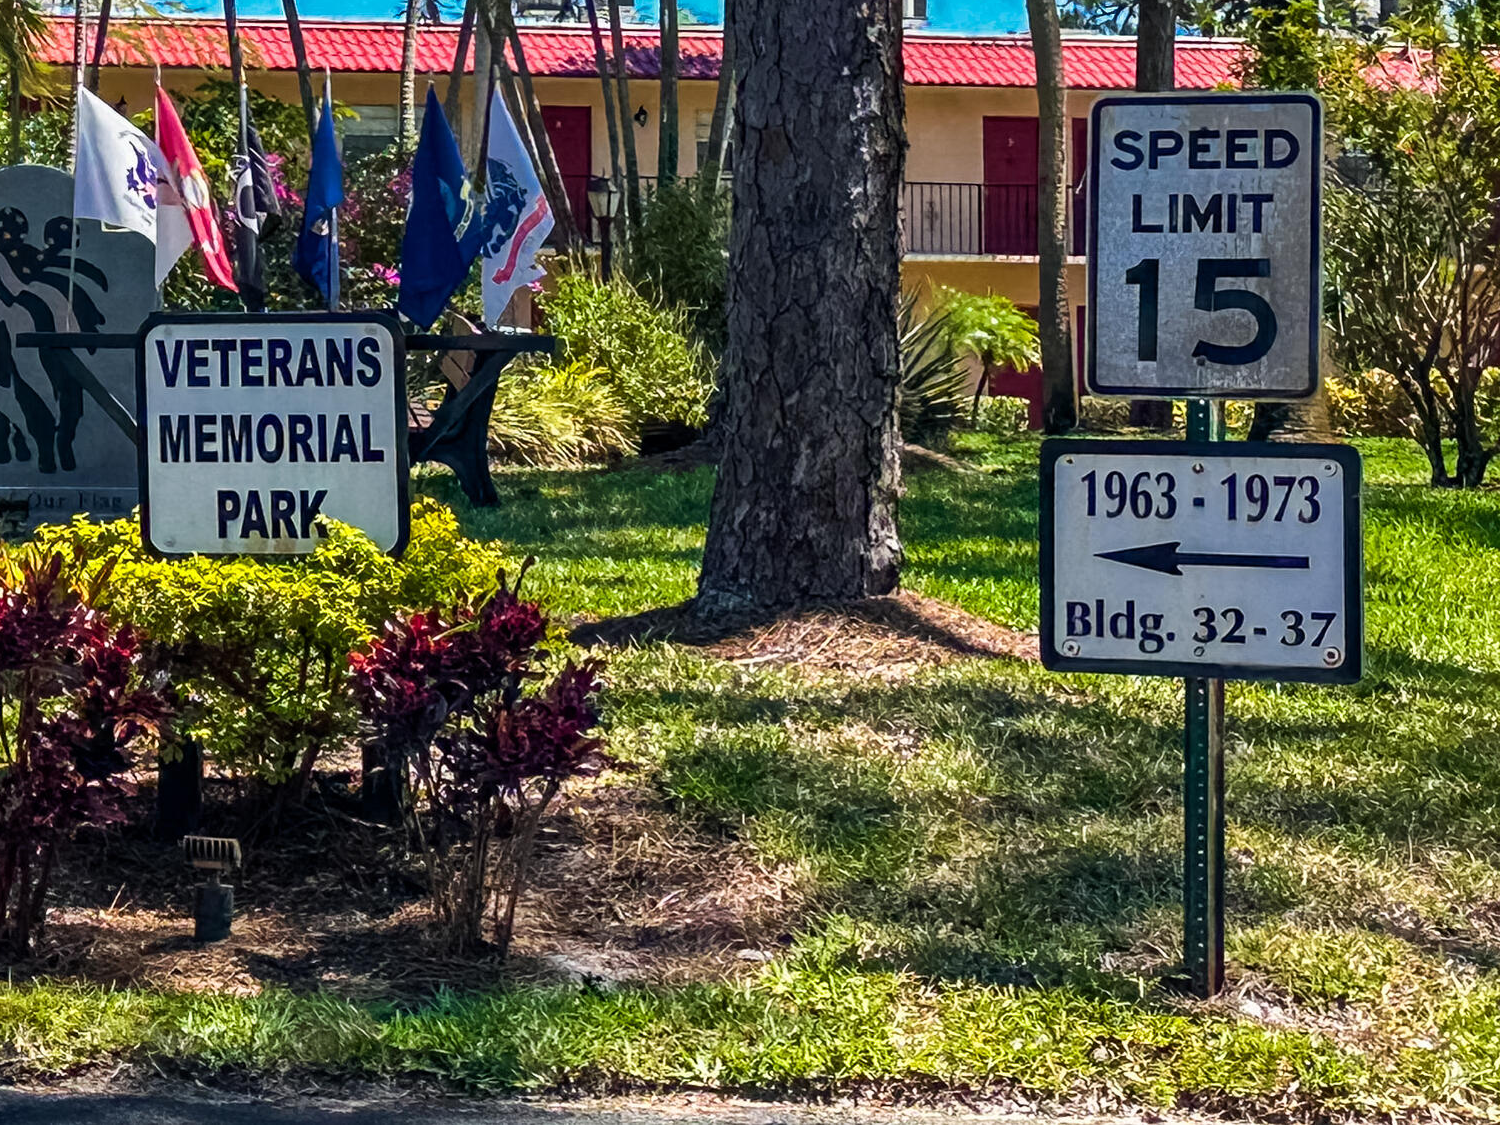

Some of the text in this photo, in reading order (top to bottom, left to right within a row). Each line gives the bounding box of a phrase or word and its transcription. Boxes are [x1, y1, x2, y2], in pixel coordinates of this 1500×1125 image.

[1111, 129, 1300, 169] SPEED
[1132, 194, 1273, 233] LIMIT
[1125, 258, 1278, 365] 15
[155, 337, 382, 387] VETERANS
[159, 414, 384, 463] MEMORIAL
[27, 491, 68, 508] Our
[217, 490, 328, 539] PARK
[1081, 470, 1177, 519] 1963
[1221, 473, 1321, 523] 1973
[1066, 599, 1175, 653] Bldg.
